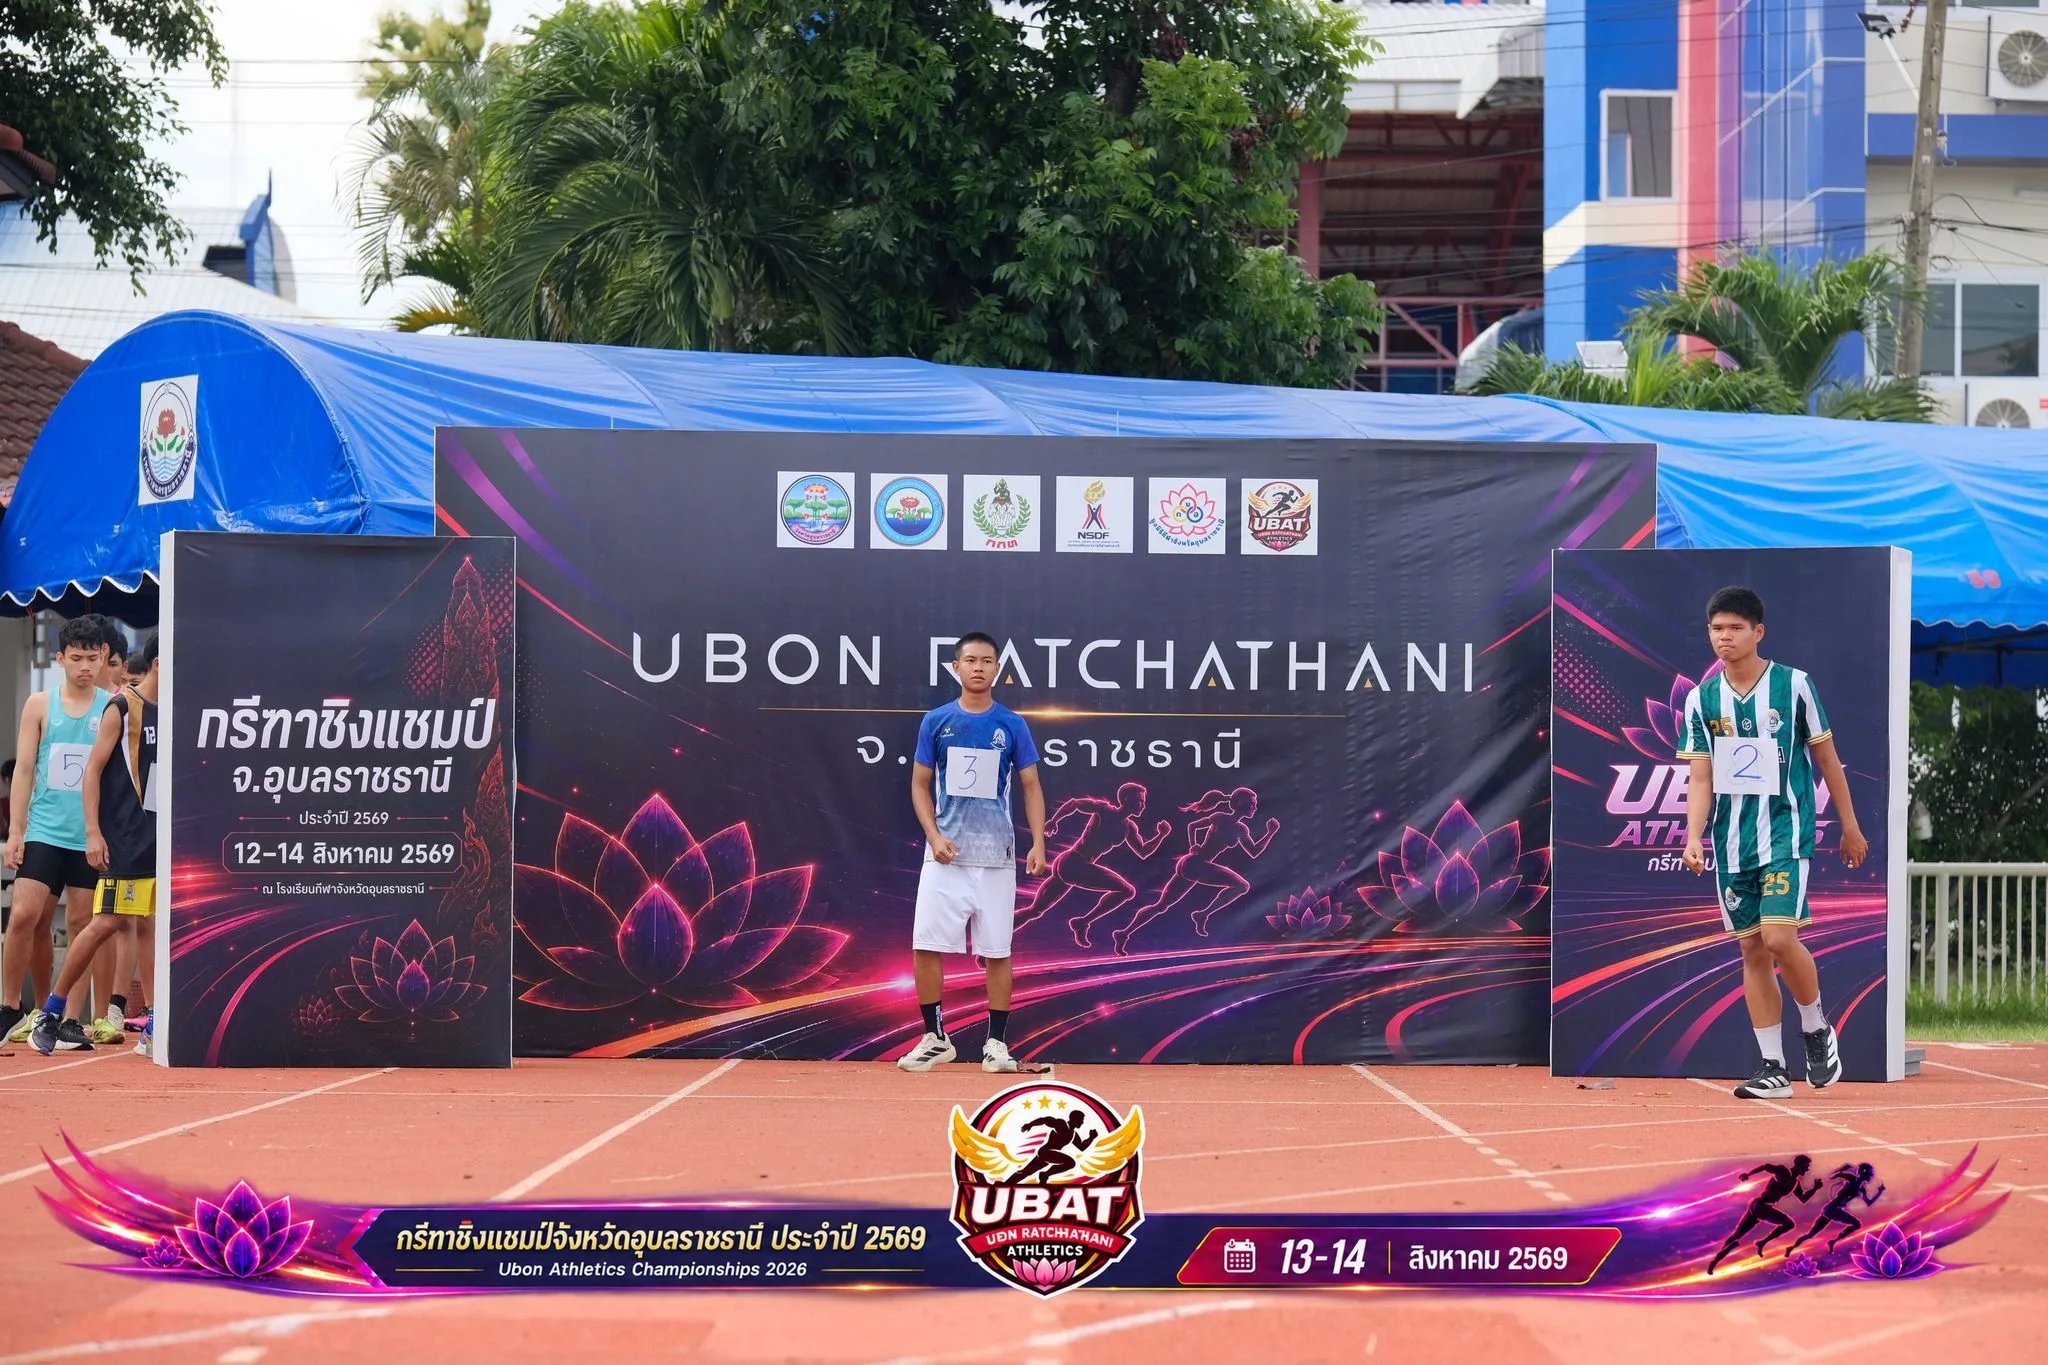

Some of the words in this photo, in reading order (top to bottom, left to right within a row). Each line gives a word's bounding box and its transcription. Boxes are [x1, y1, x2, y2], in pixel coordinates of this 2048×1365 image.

[1077, 531, 1109, 540] NSDF
[1253, 517, 1306, 531] UBAT
[632, 632, 881, 686] UBON
[197, 695, 497, 750] กรีฑาชิงแชมป์
[63, 753, 84, 788] 5
[958, 755, 978, 790] 3
[1732, 744, 1762, 780] 2
[232, 756, 453, 804] จ.อุบลราชธานี
[299, 809, 349, 826] ประจำปี
[353, 811, 389, 825] 2569
[312, 842, 393, 864] สิงหาคม
[401, 843, 455, 864] 2569
[276, 881, 425, 897] โรงเรียนกีฬาจังหวัดอุบลราชธานี
[1762, 870, 1791, 897] 25
